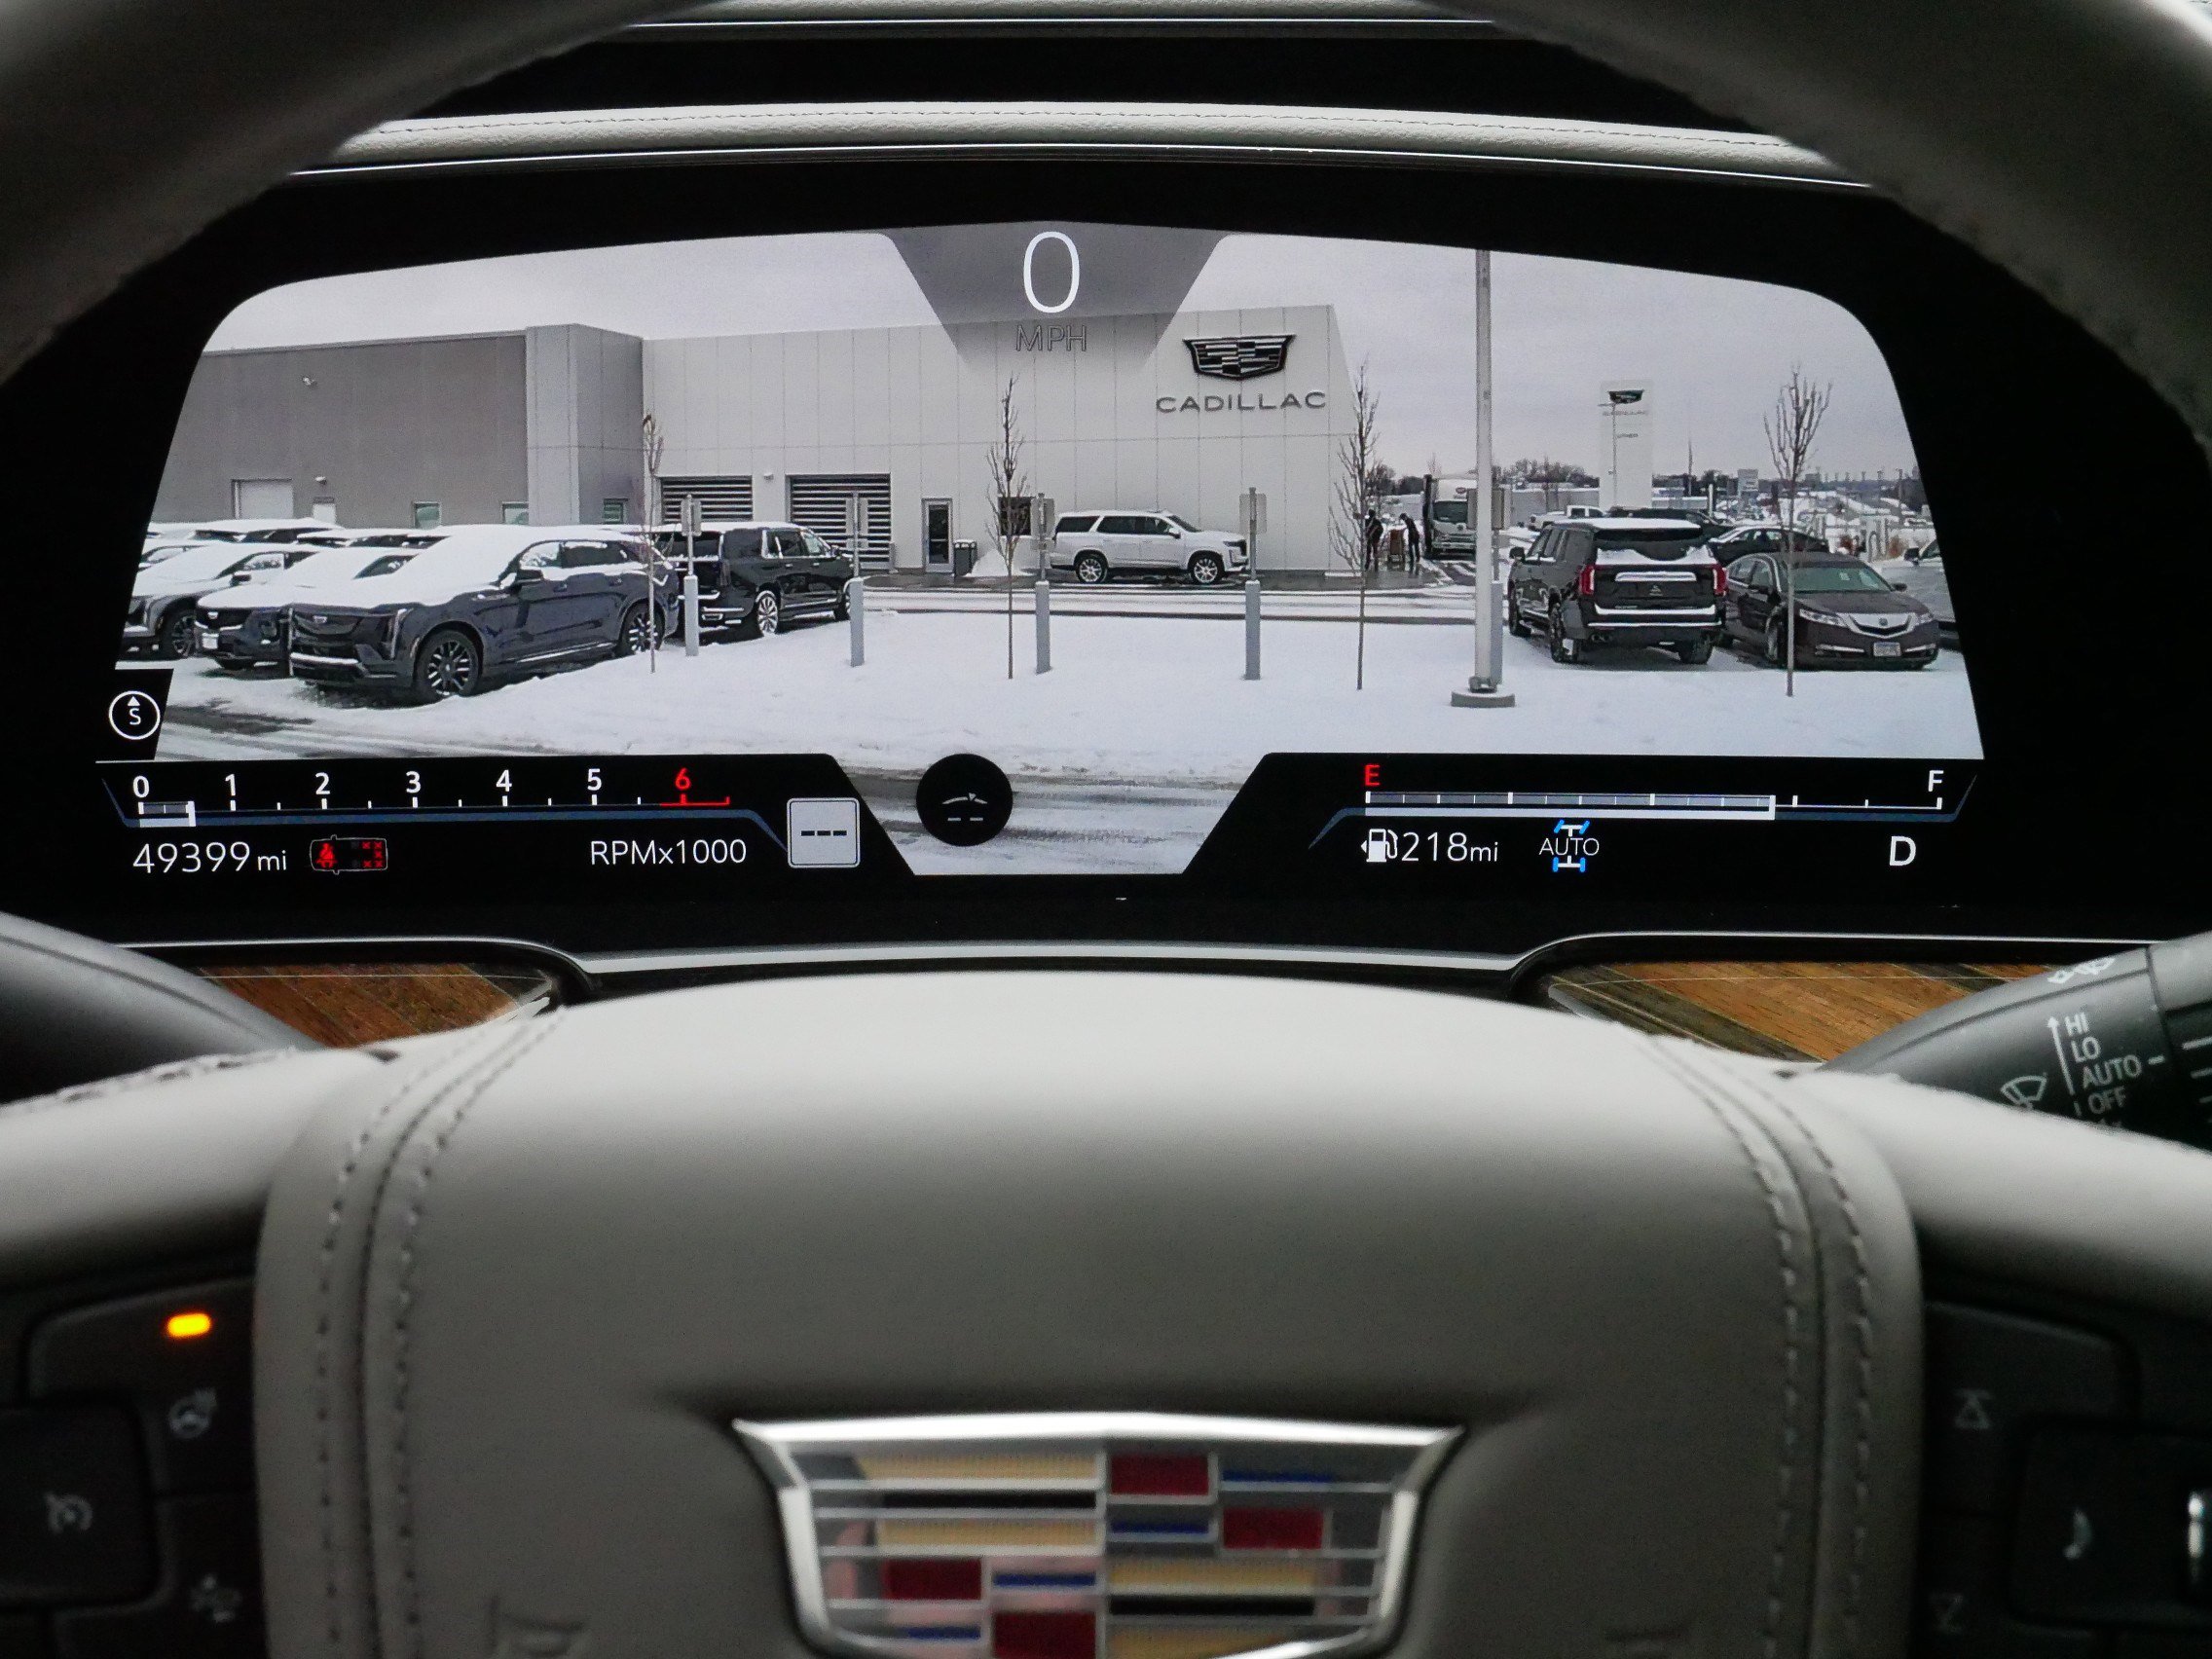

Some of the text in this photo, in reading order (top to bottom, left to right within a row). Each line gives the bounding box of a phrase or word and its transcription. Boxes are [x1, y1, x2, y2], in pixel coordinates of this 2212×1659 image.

[1023, 231, 1080, 313] 0
[1015, 324, 1087, 352] MPH
[1156, 390, 1326, 414] CADILLAC
[129, 709, 141, 725] S
[132, 767, 691, 798] 0 1 2 3 4 5 6
[1365, 764, 1381, 787] E
[1928, 770, 1944, 792] F
[132, 841, 287, 873] 49399 mi
[590, 838, 748, 866] RPMx1000
[1538, 837, 1600, 856] AUTO
[1889, 835, 1917, 866] D
[2063, 1011, 2089, 1037] HI
[2070, 1036, 2101, 1063] LO
[2082, 1054, 2142, 1088] AUTO
[2087, 1086, 2126, 1115] OFF
